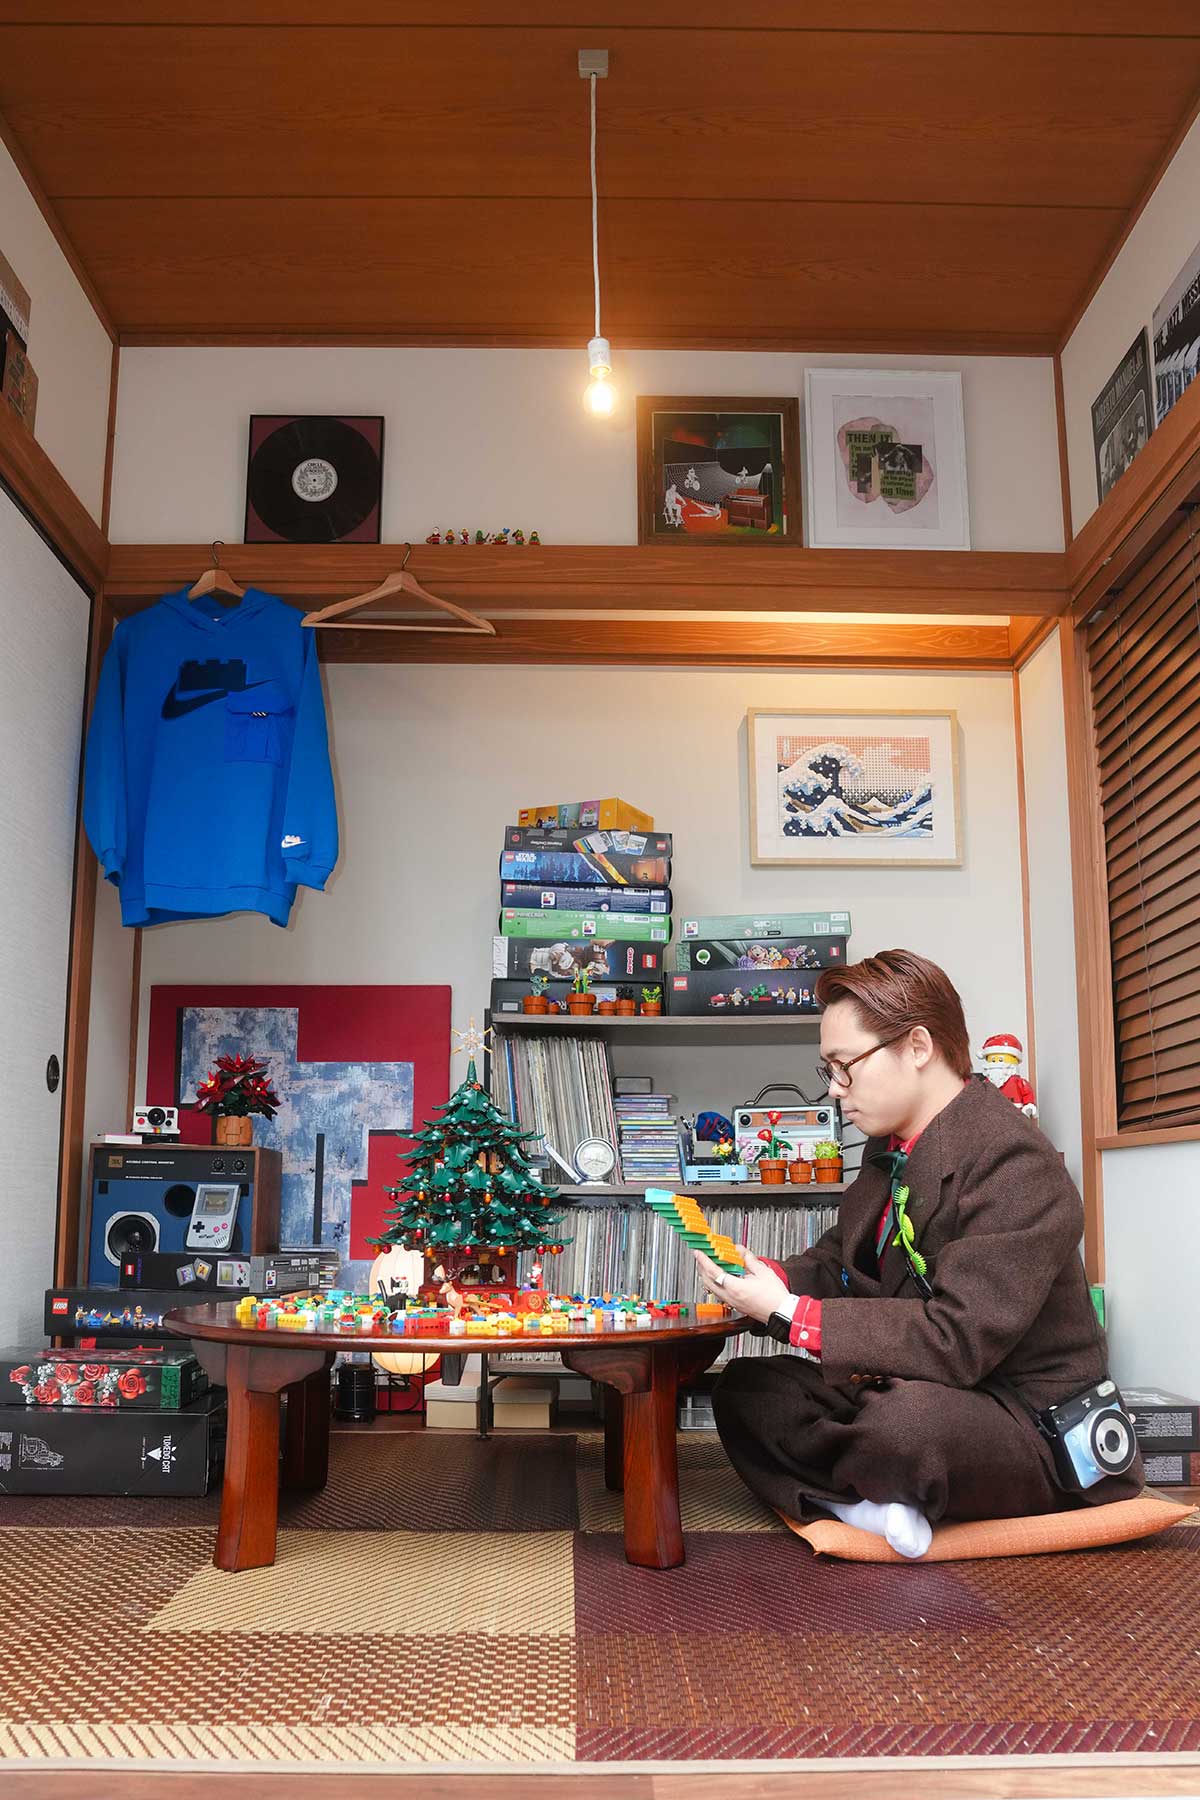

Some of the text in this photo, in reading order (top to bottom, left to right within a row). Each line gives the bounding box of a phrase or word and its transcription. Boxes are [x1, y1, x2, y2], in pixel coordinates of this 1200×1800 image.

[847, 433, 876, 443] THEN
[161, 1434, 172, 1474] TUXEDO CAT
